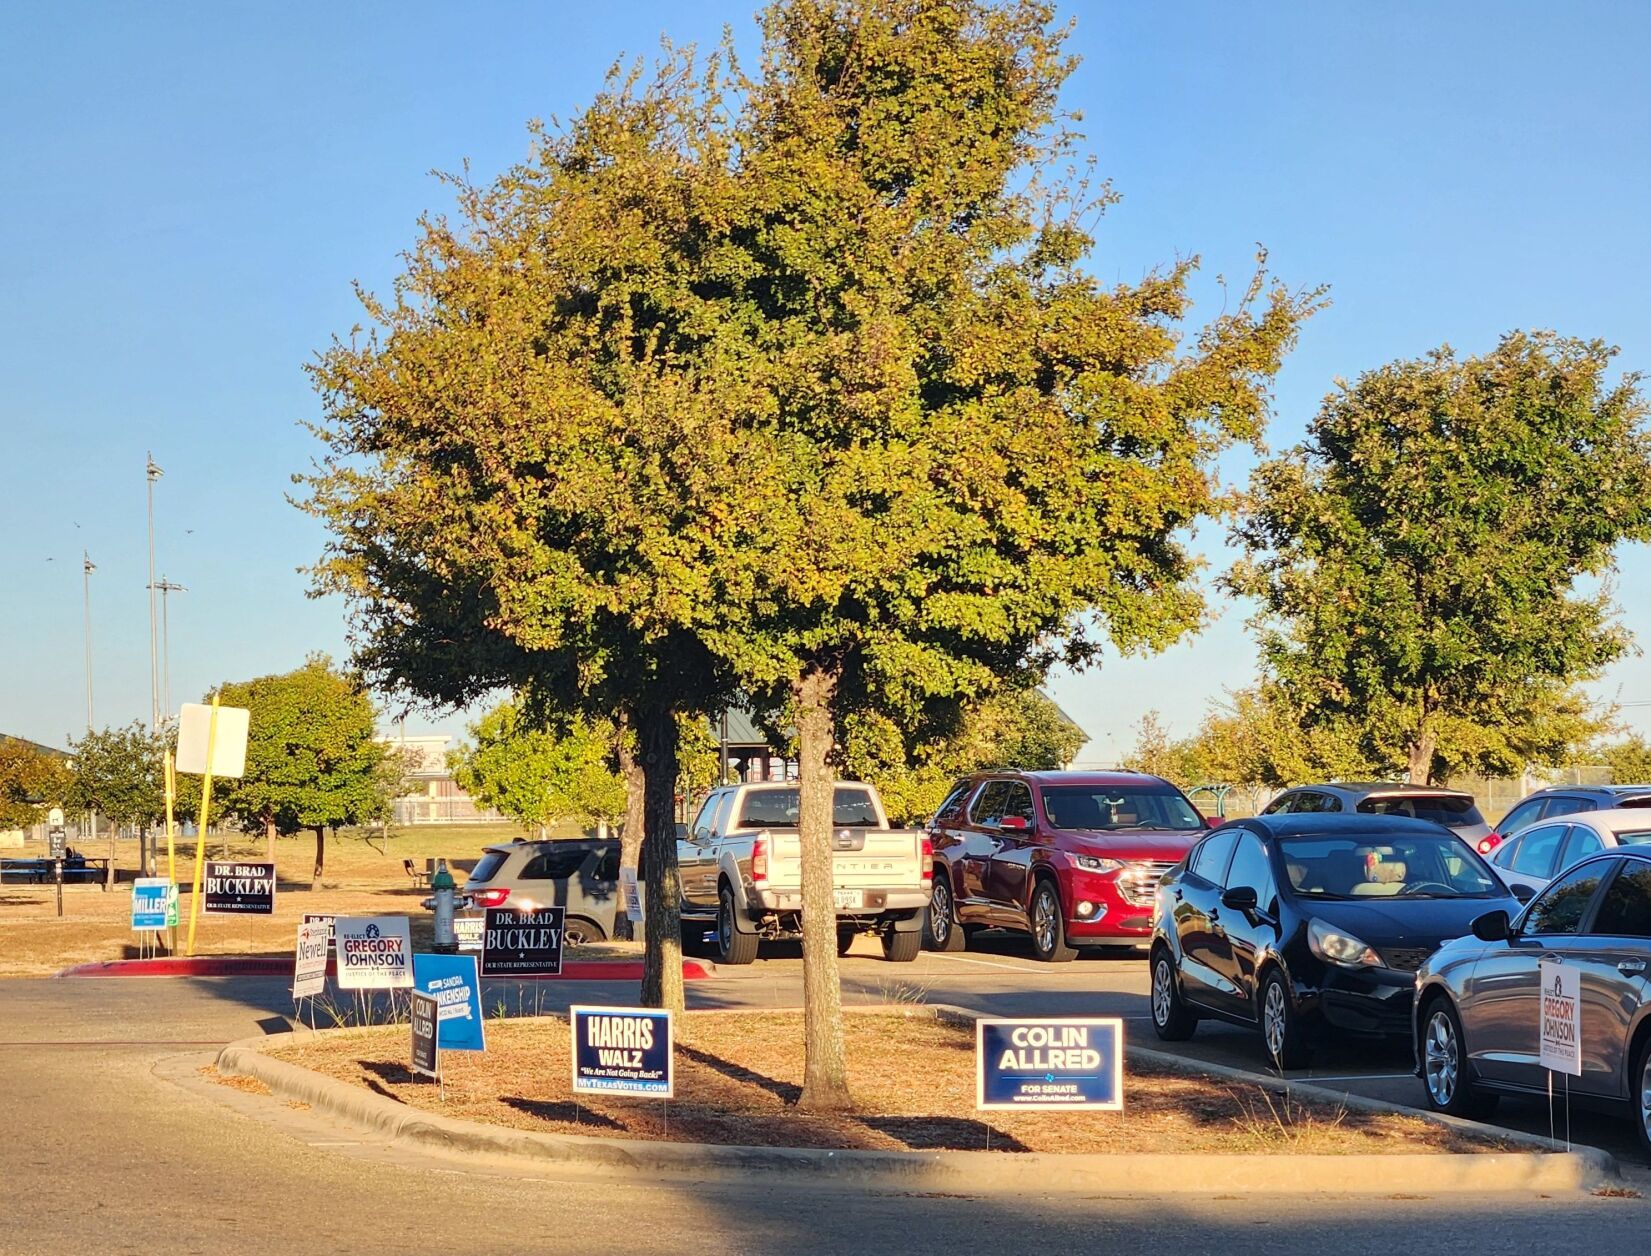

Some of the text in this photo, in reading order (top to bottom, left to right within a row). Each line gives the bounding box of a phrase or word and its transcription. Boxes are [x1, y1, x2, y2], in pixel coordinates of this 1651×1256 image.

[214, 865, 266, 877] DR. BRAD
[207, 877, 273, 895] BUCKLEY
[133, 897, 166, 914] MILLER
[454, 921, 484, 934] HARRIS
[495, 912, 554, 925] DR. BRAD
[298, 935, 327, 961] Newell
[344, 939, 403, 953] GREGORY
[485, 928, 561, 950] BUCKLEY
[345, 953, 405, 967] JOHNSON
[442, 975, 464, 989] SANDRA
[416, 998, 432, 1019] COLIN
[1544, 997, 1575, 1021] GREGORY
[414, 1017, 434, 1039] ALLRED
[587, 1016, 654, 1050] HARRIS
[1011, 1026, 1088, 1048] COLIN
[1543, 1016, 1575, 1042] JOHNSON
[598, 1049, 643, 1068] WALZ
[998, 1048, 1101, 1070] ALLRED
[594, 1068, 606, 1076] Are
[606, 1068, 618, 1077] Not
[618, 1069, 638, 1079] Going
[1013, 1094, 1086, 1102] www.ColinAllred.com
[1021, 1085, 1078, 1094] FOR SENATE
